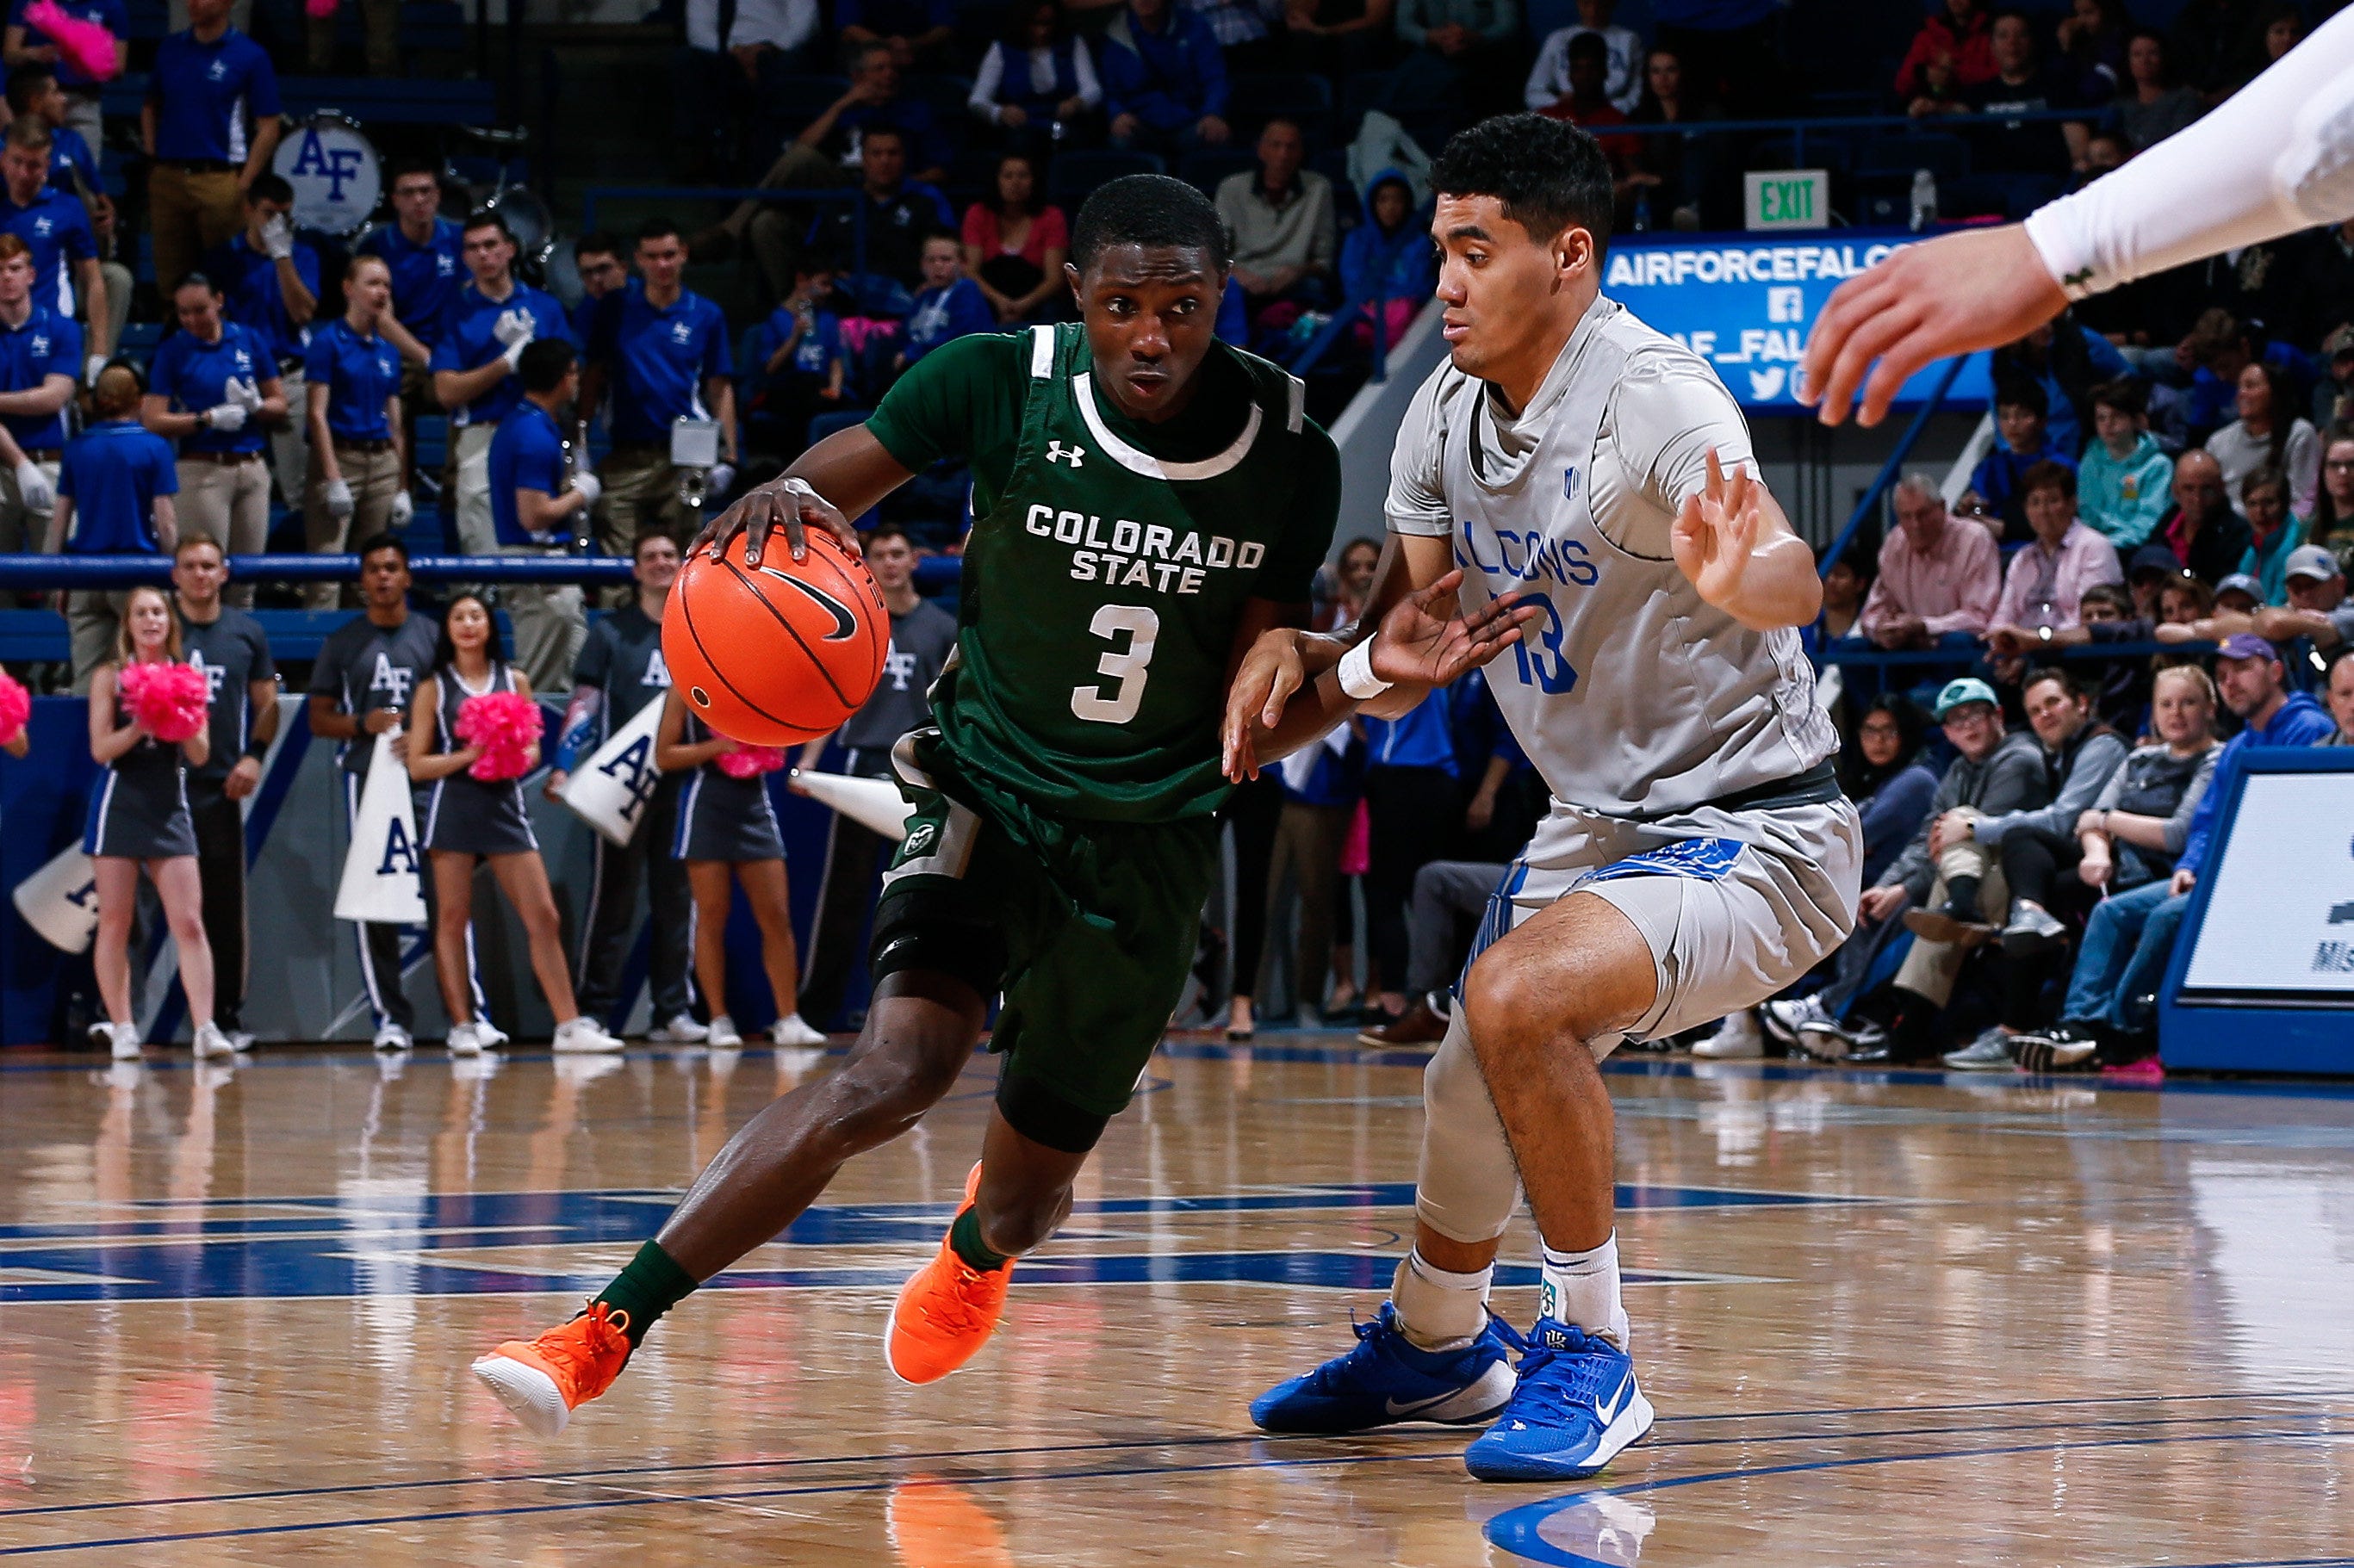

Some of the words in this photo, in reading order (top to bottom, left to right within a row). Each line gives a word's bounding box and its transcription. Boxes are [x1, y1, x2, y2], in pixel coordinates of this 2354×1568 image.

[291, 127, 363, 201] AF
[1761, 179, 1813, 221] EXIT
[1607, 244, 1912, 287] AIRFORCEFALC
[1026, 504, 1266, 569] COLORADO
[1071, 550, 1206, 594] STATE
[369, 652, 413, 705] AF
[1071, 604, 1159, 724] 3
